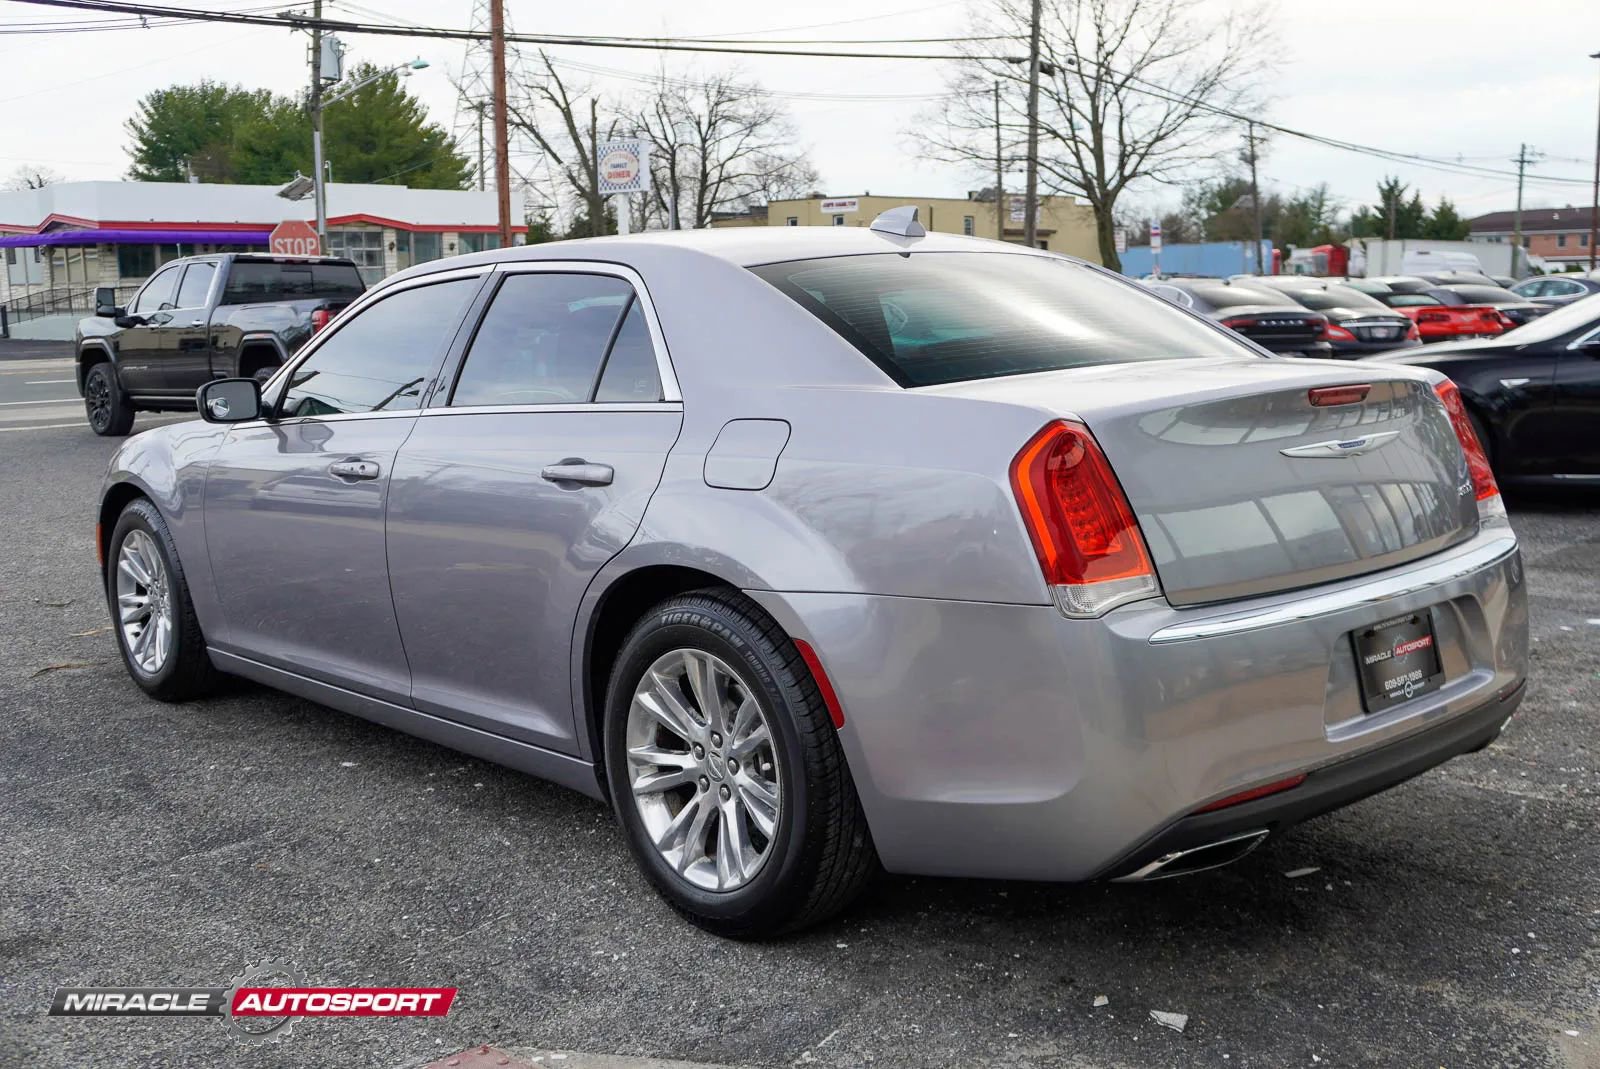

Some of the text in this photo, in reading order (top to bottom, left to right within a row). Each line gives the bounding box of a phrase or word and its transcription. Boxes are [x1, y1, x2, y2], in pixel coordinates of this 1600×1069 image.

[607, 170, 631, 179] DINER
[274, 237, 317, 256] STOP
[661, 612, 771, 682] TIGER PAW TOURING
[1364, 636, 1431, 665] MIRACLE AUTOSPORT
